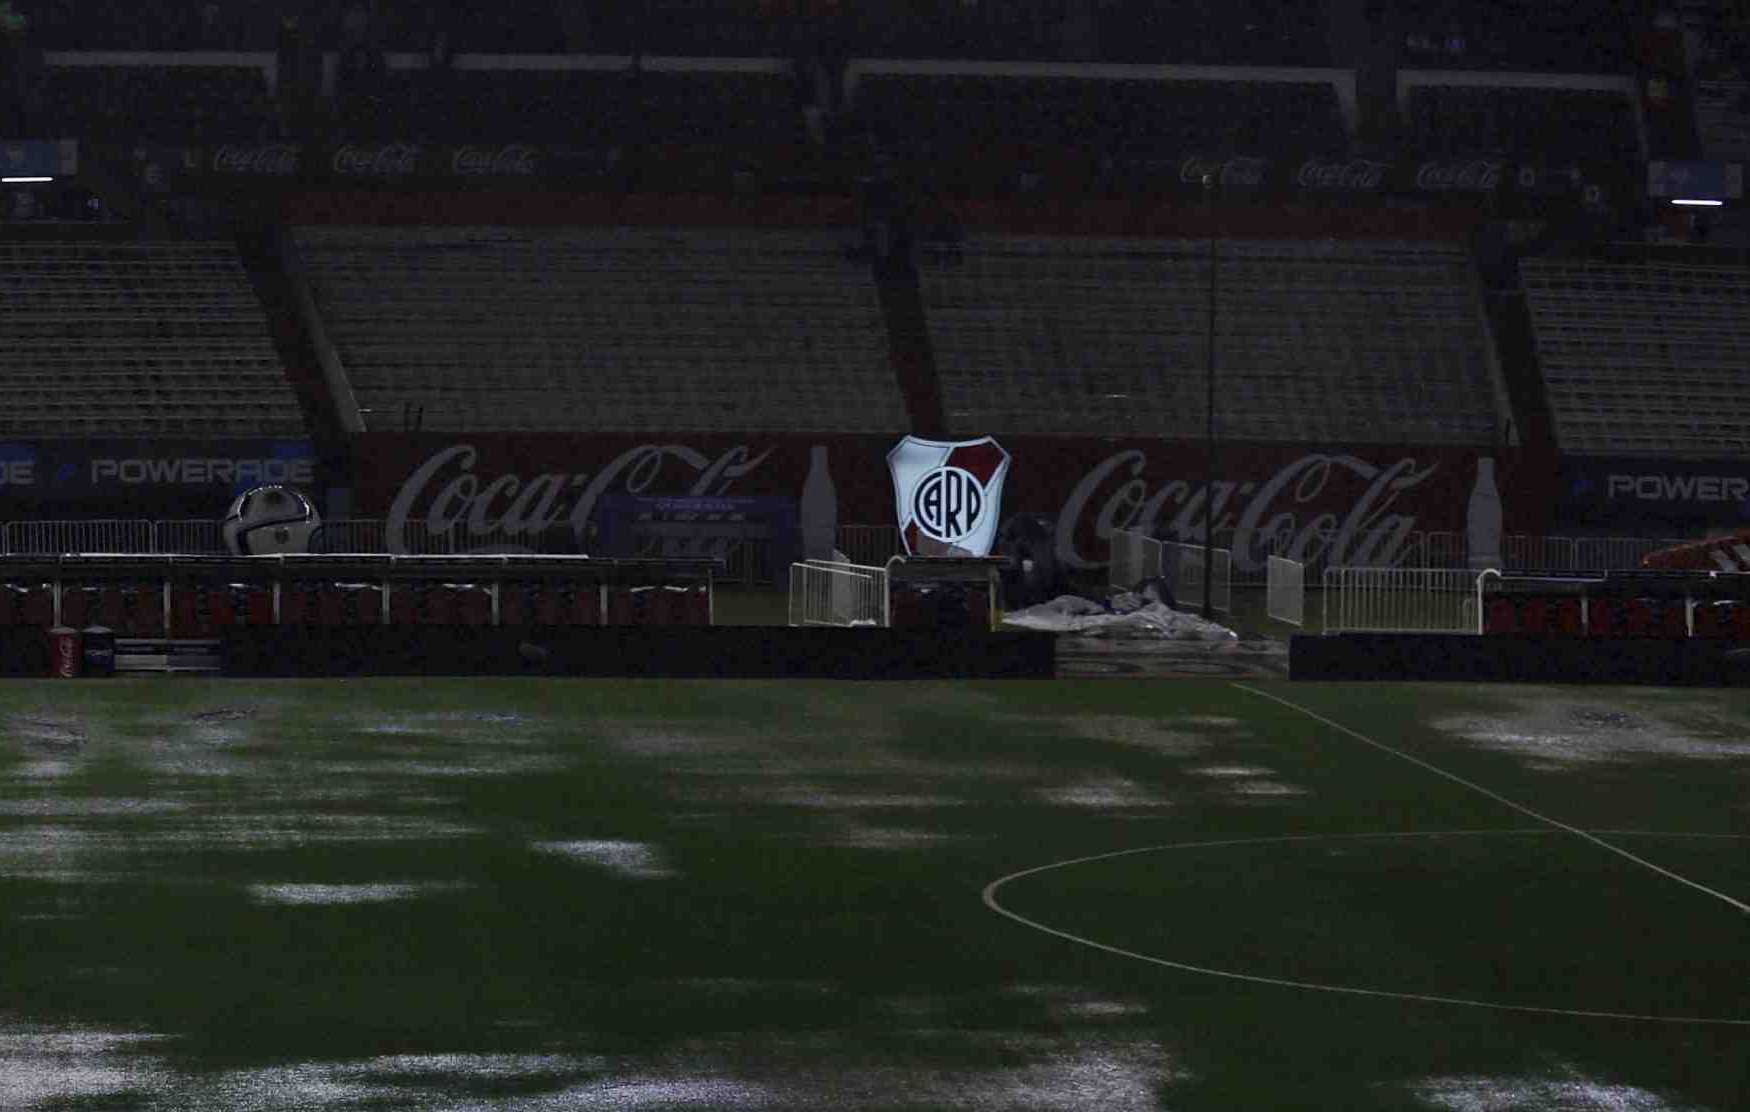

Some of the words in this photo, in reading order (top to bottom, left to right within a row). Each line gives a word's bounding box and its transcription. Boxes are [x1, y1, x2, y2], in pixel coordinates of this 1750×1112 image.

[91, 456, 314, 485] POWERADE
[385, 443, 773, 558] Coca-C
[1056, 449, 1440, 576] Coca-Cola
